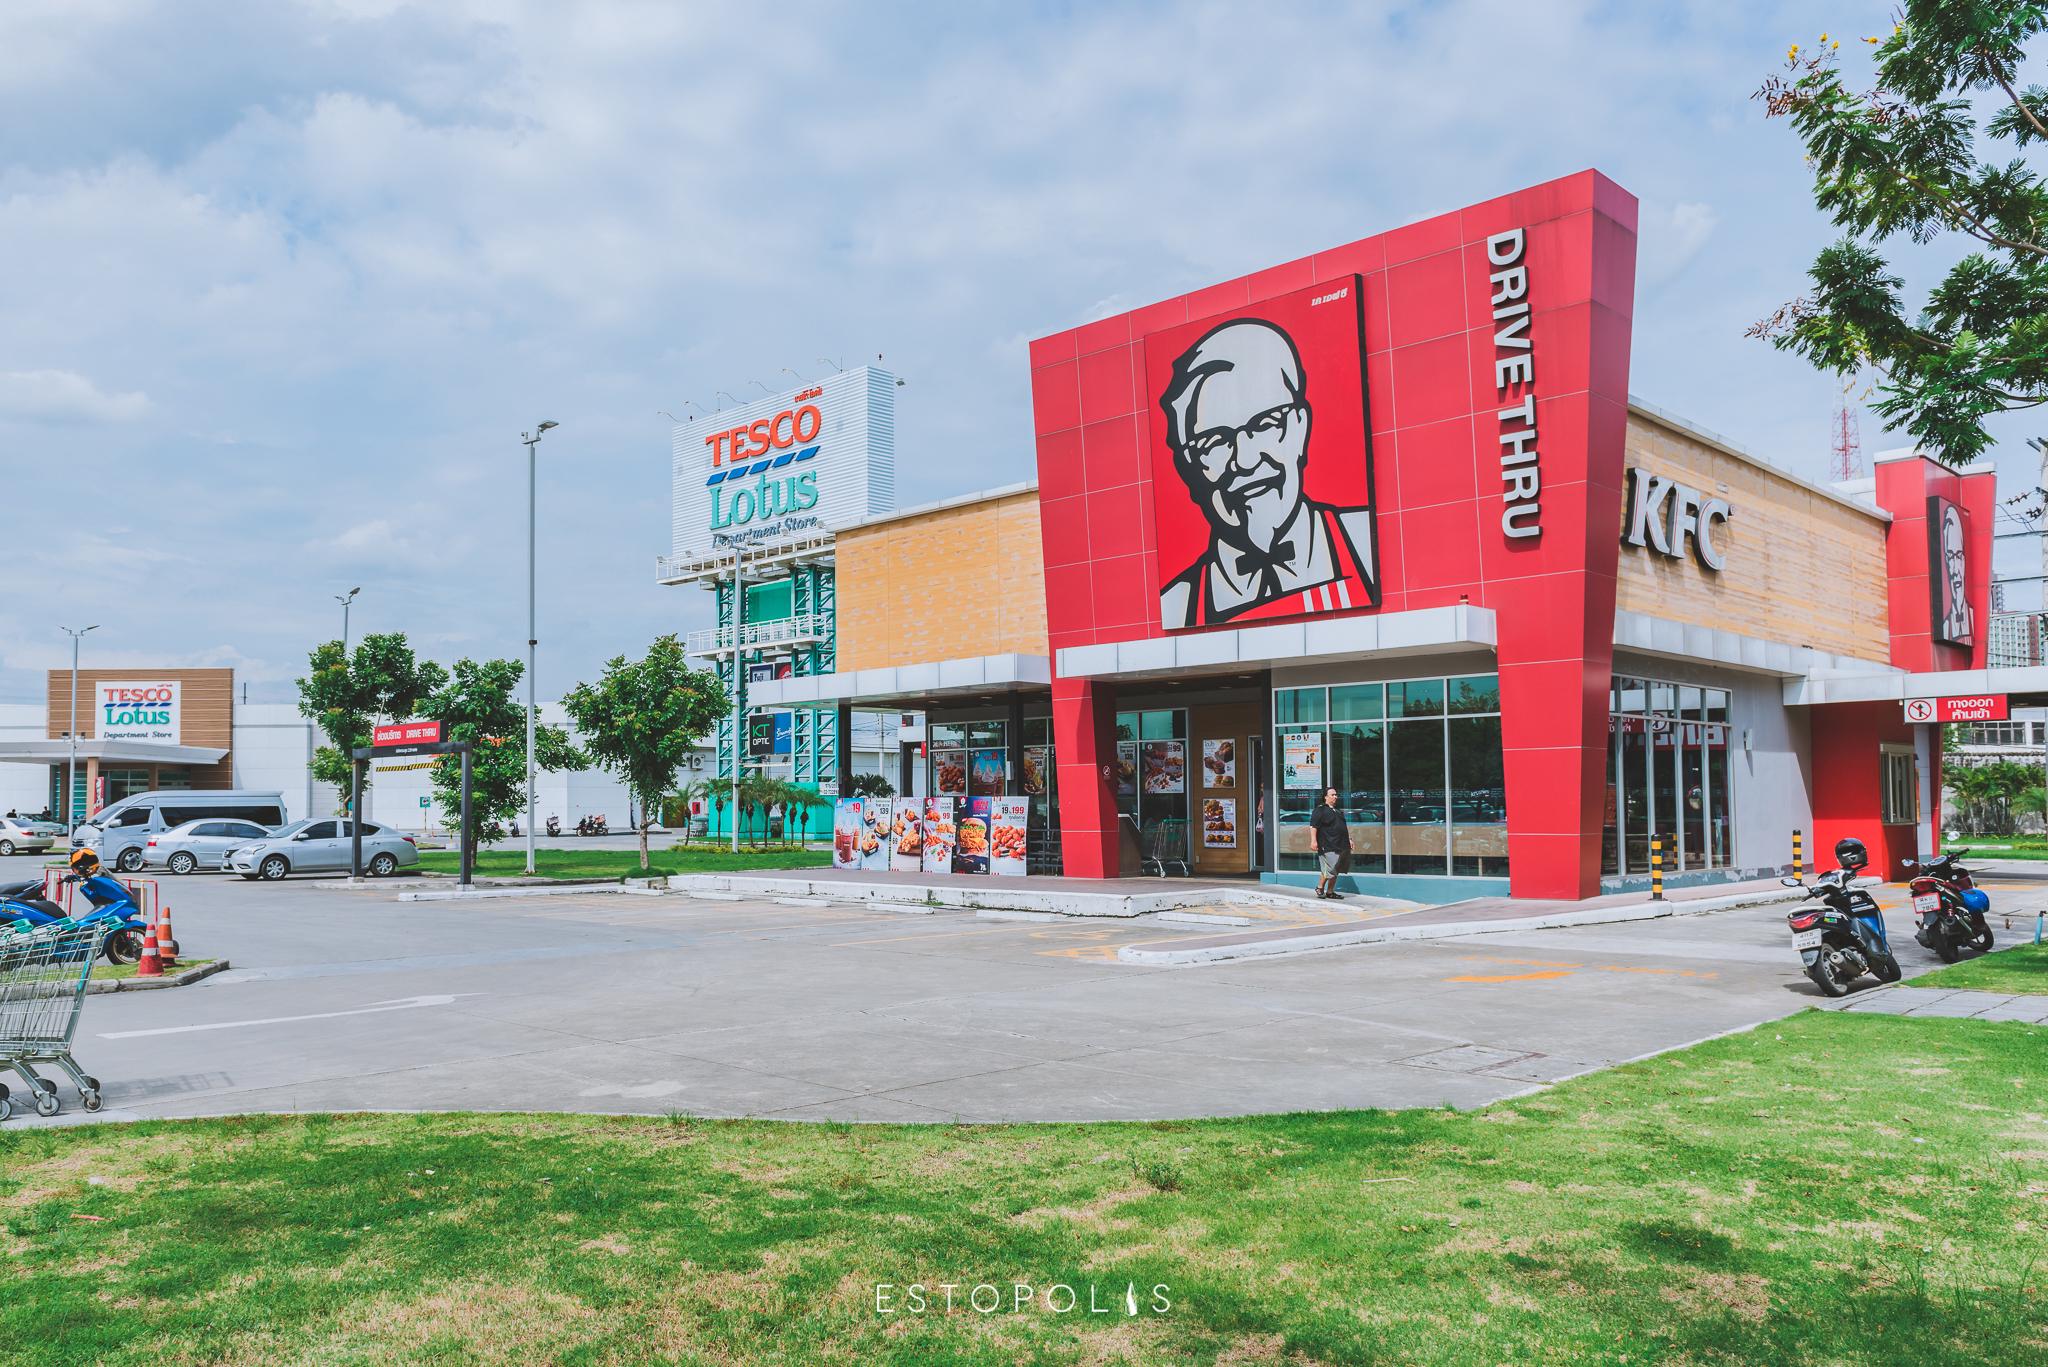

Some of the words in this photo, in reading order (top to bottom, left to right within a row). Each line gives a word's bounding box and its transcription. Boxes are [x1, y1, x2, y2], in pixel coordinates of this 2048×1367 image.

[1487, 228, 1534, 389] DRIVE
[705, 404, 822, 467] TESCO
[1498, 394, 1542, 538] THRU
[709, 470, 819, 530] Lotus
[784, 516, 818, 532] Store
[1621, 467, 1729, 573] KFC
[103, 688, 173, 702] TESCO
[1947, 698, 1994, 709] ทางออก
[105, 706, 170, 725] Lotus
[1951, 708, 1991, 720] ห้ามเข้า
[103, 731, 148, 739] Department
[406, 729, 421, 738] DRIVE
[422, 727, 437, 737] THRU
[852, 802, 861, 813] 19
[1001, 806, 1009, 814] 19
[1012, 806, 1025, 814] 199
